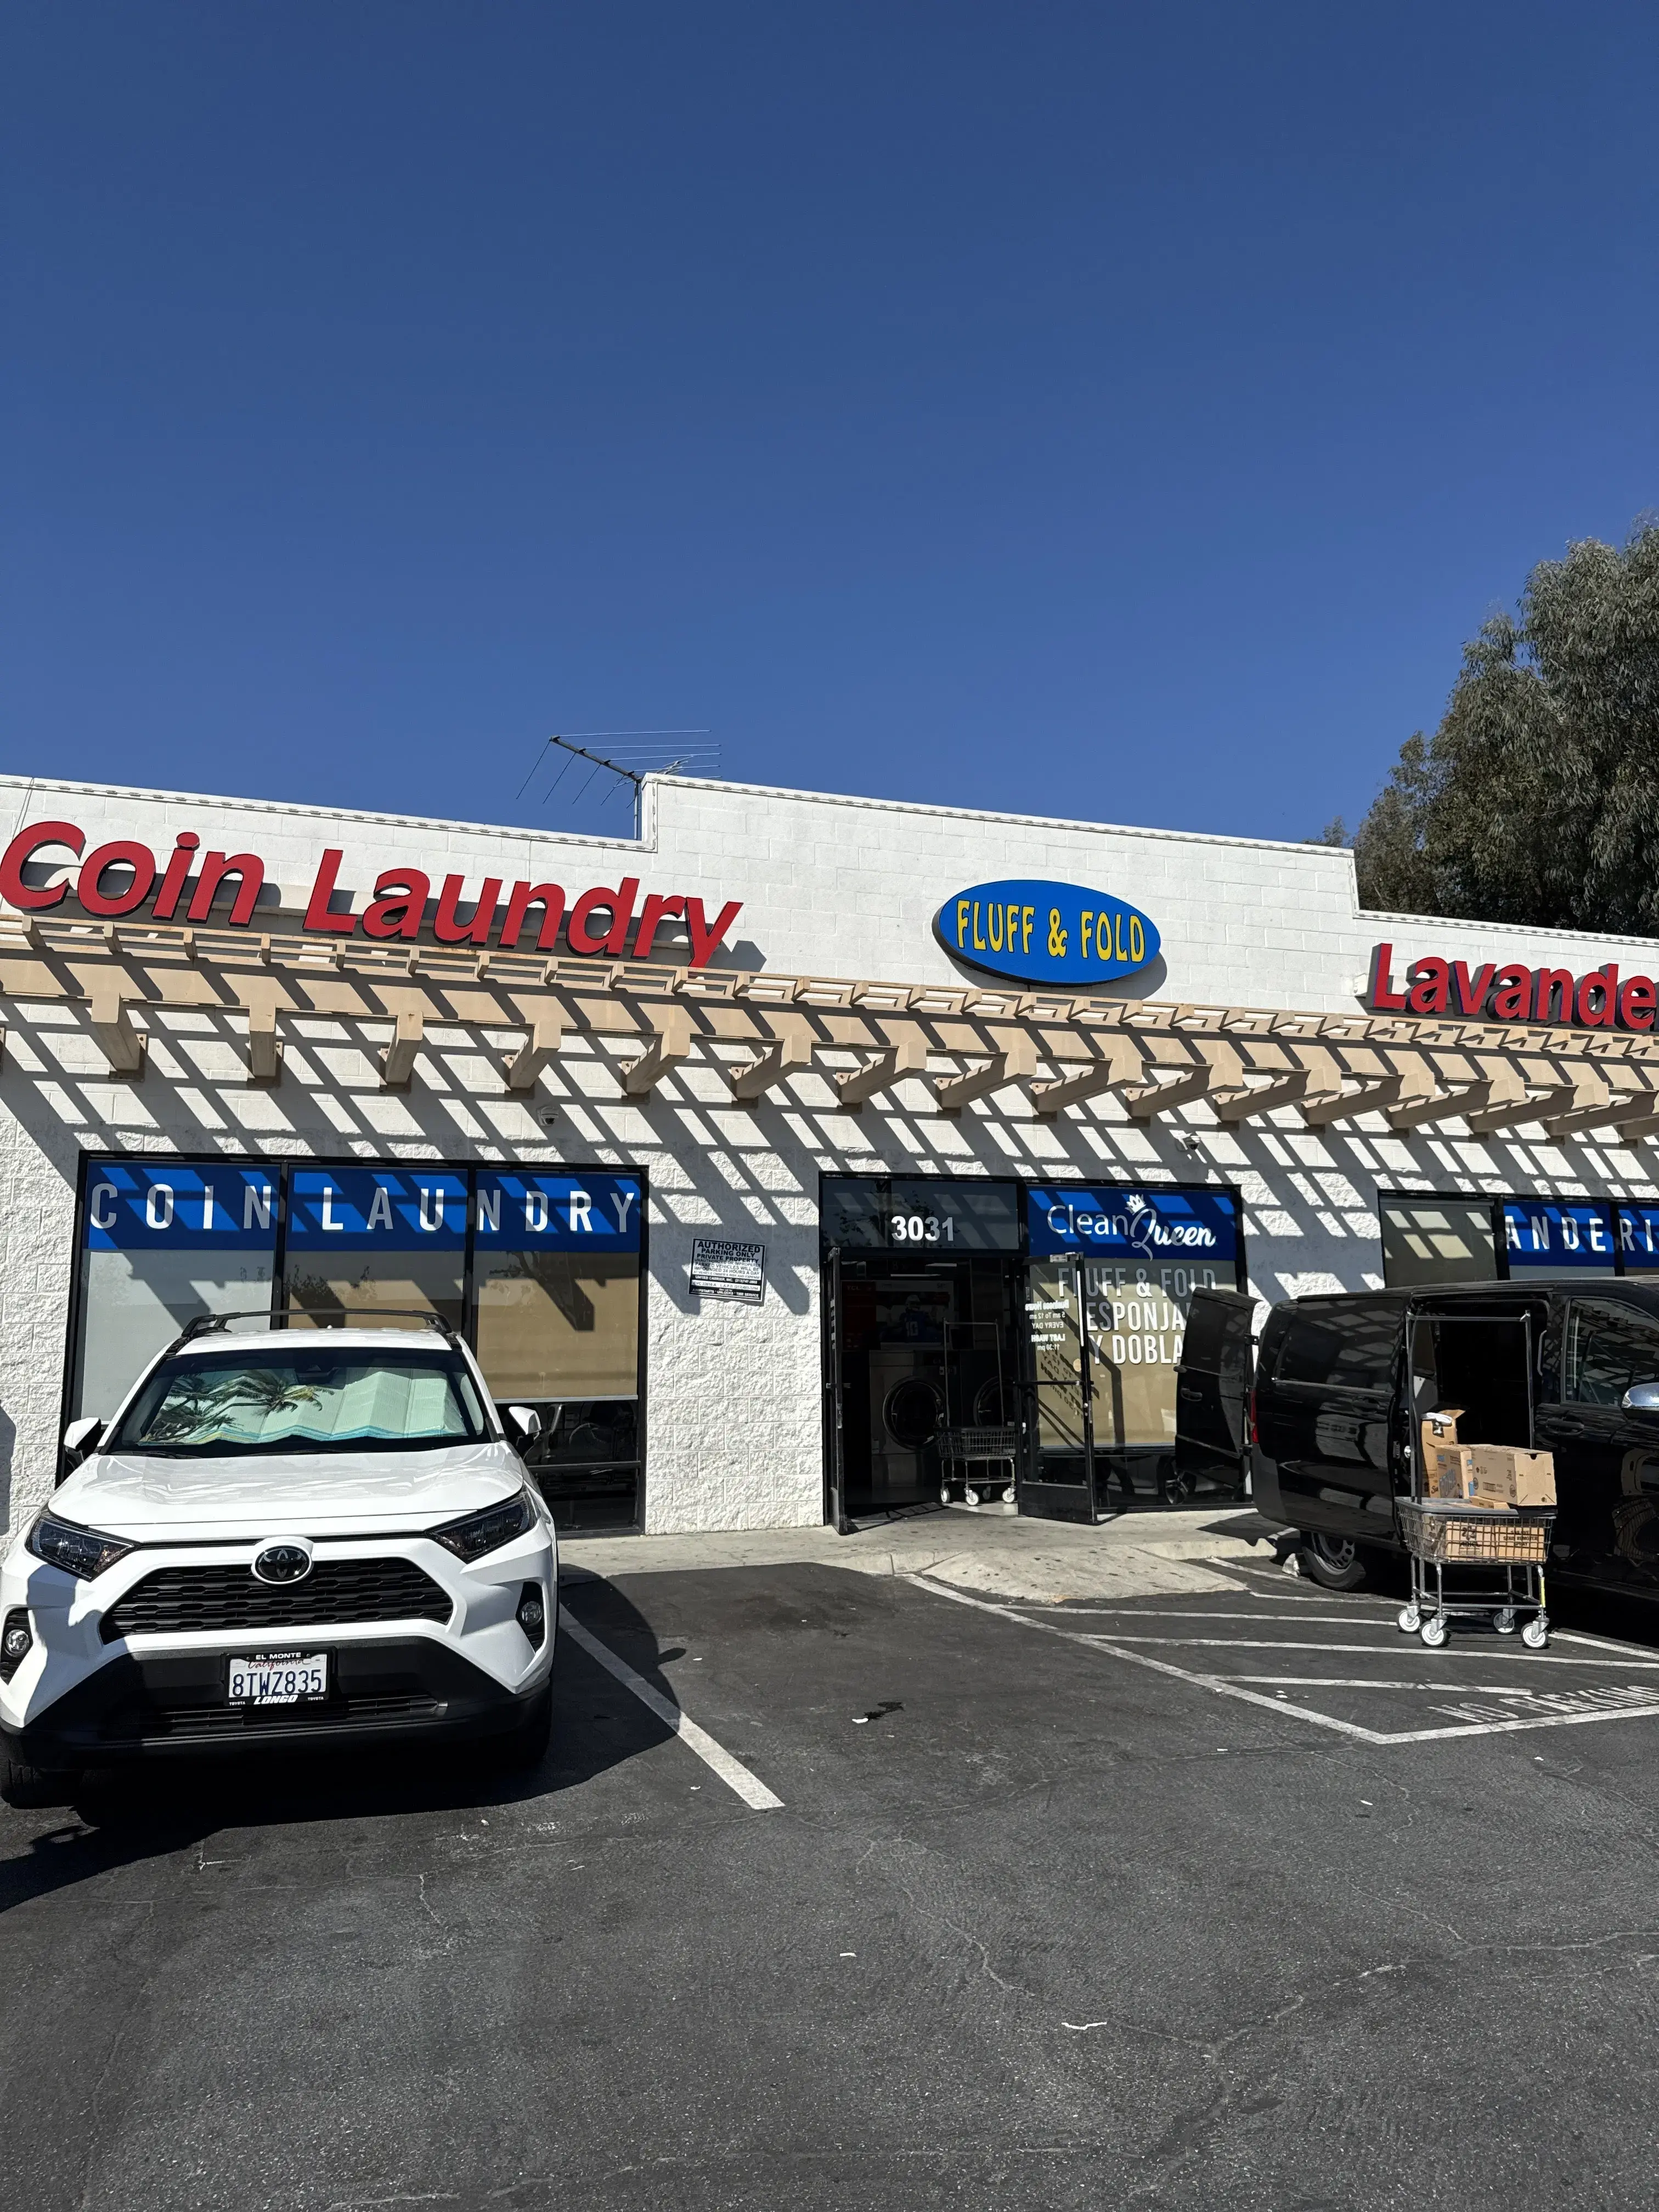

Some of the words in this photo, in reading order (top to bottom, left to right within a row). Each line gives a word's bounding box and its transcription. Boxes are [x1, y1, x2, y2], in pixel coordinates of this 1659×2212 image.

[0, 821, 265, 927] Coin
[303, 849, 744, 970] Laundry
[956, 900, 1035, 955] FLUFF
[1047, 907, 1069, 958] &
[1080, 910, 1146, 963] FOLD
[89, 1182, 272, 1230] COIN
[321, 1186, 634, 1233] LAUNDRY
[891, 1215, 954, 1242] 3031
[1047, 1204, 1128, 1235] Clean
[1130, 1208, 1217, 1261] Queen
[697, 1241, 761, 1253] AUTHORIZED
[701, 1248, 734, 1256] PARKING
[1136, 1268, 1153, 1297] &
[232, 1669, 322, 1697] 8TWZ835
[253, 1694, 298, 1705] LONGO
